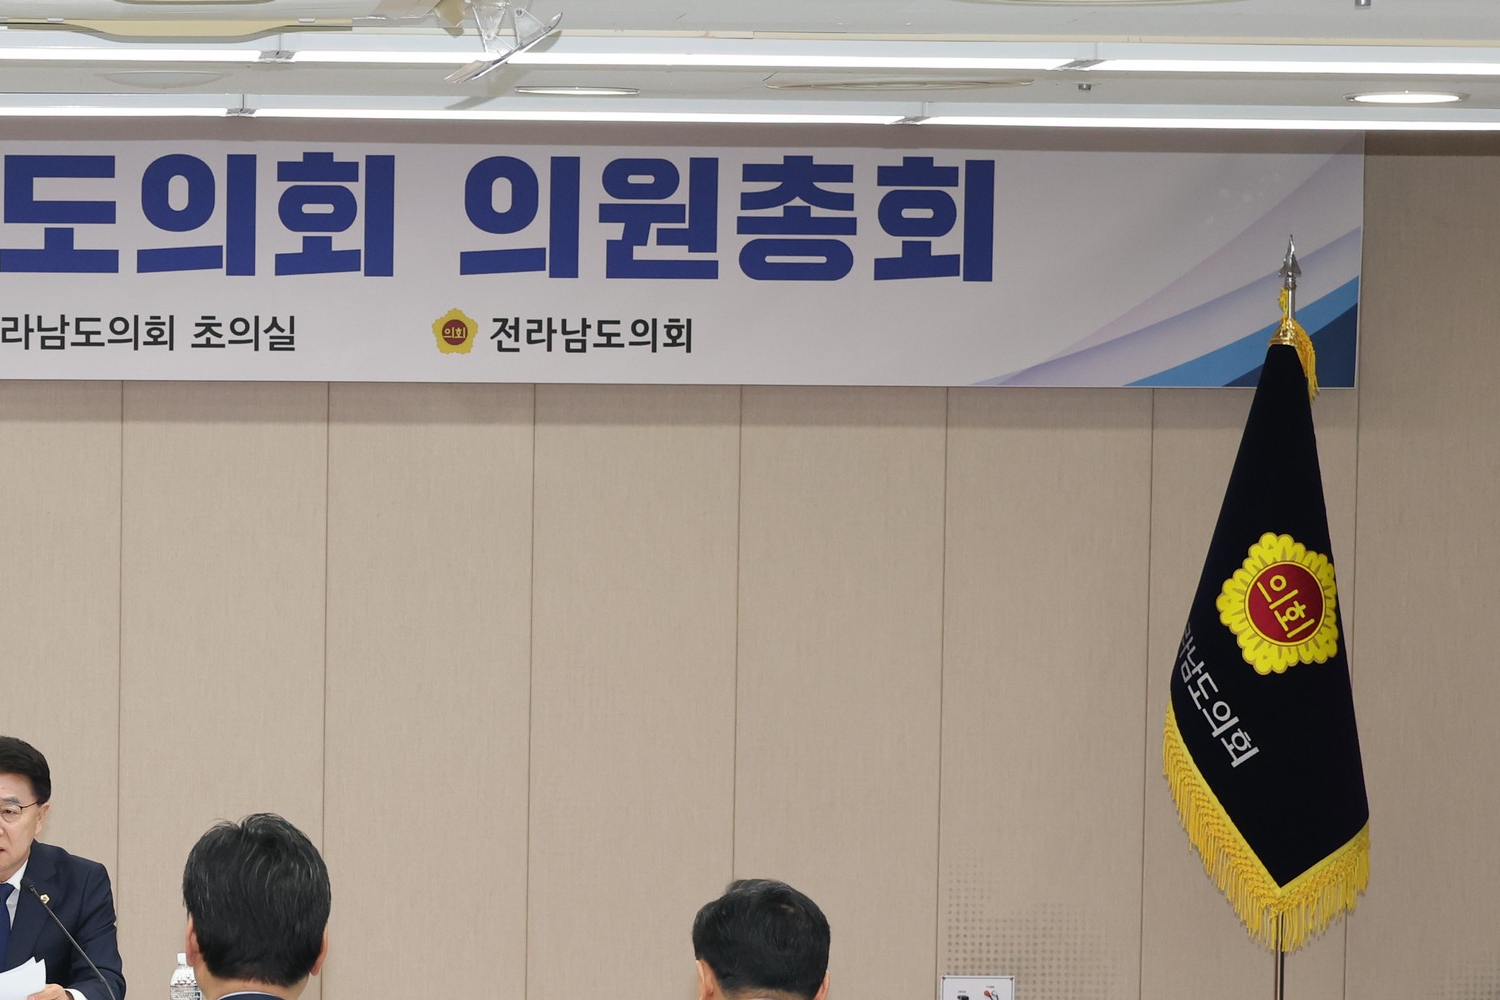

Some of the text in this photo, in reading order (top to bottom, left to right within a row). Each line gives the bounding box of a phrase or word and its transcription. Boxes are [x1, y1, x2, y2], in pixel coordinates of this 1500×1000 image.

[459, 154, 996, 284] 의원총회
[190, 315, 296, 352] 초의실
[443, 326, 466, 339] 의회
[489, 316, 692, 354] 전라남도의회
[1256, 574, 1315, 639] 의회
